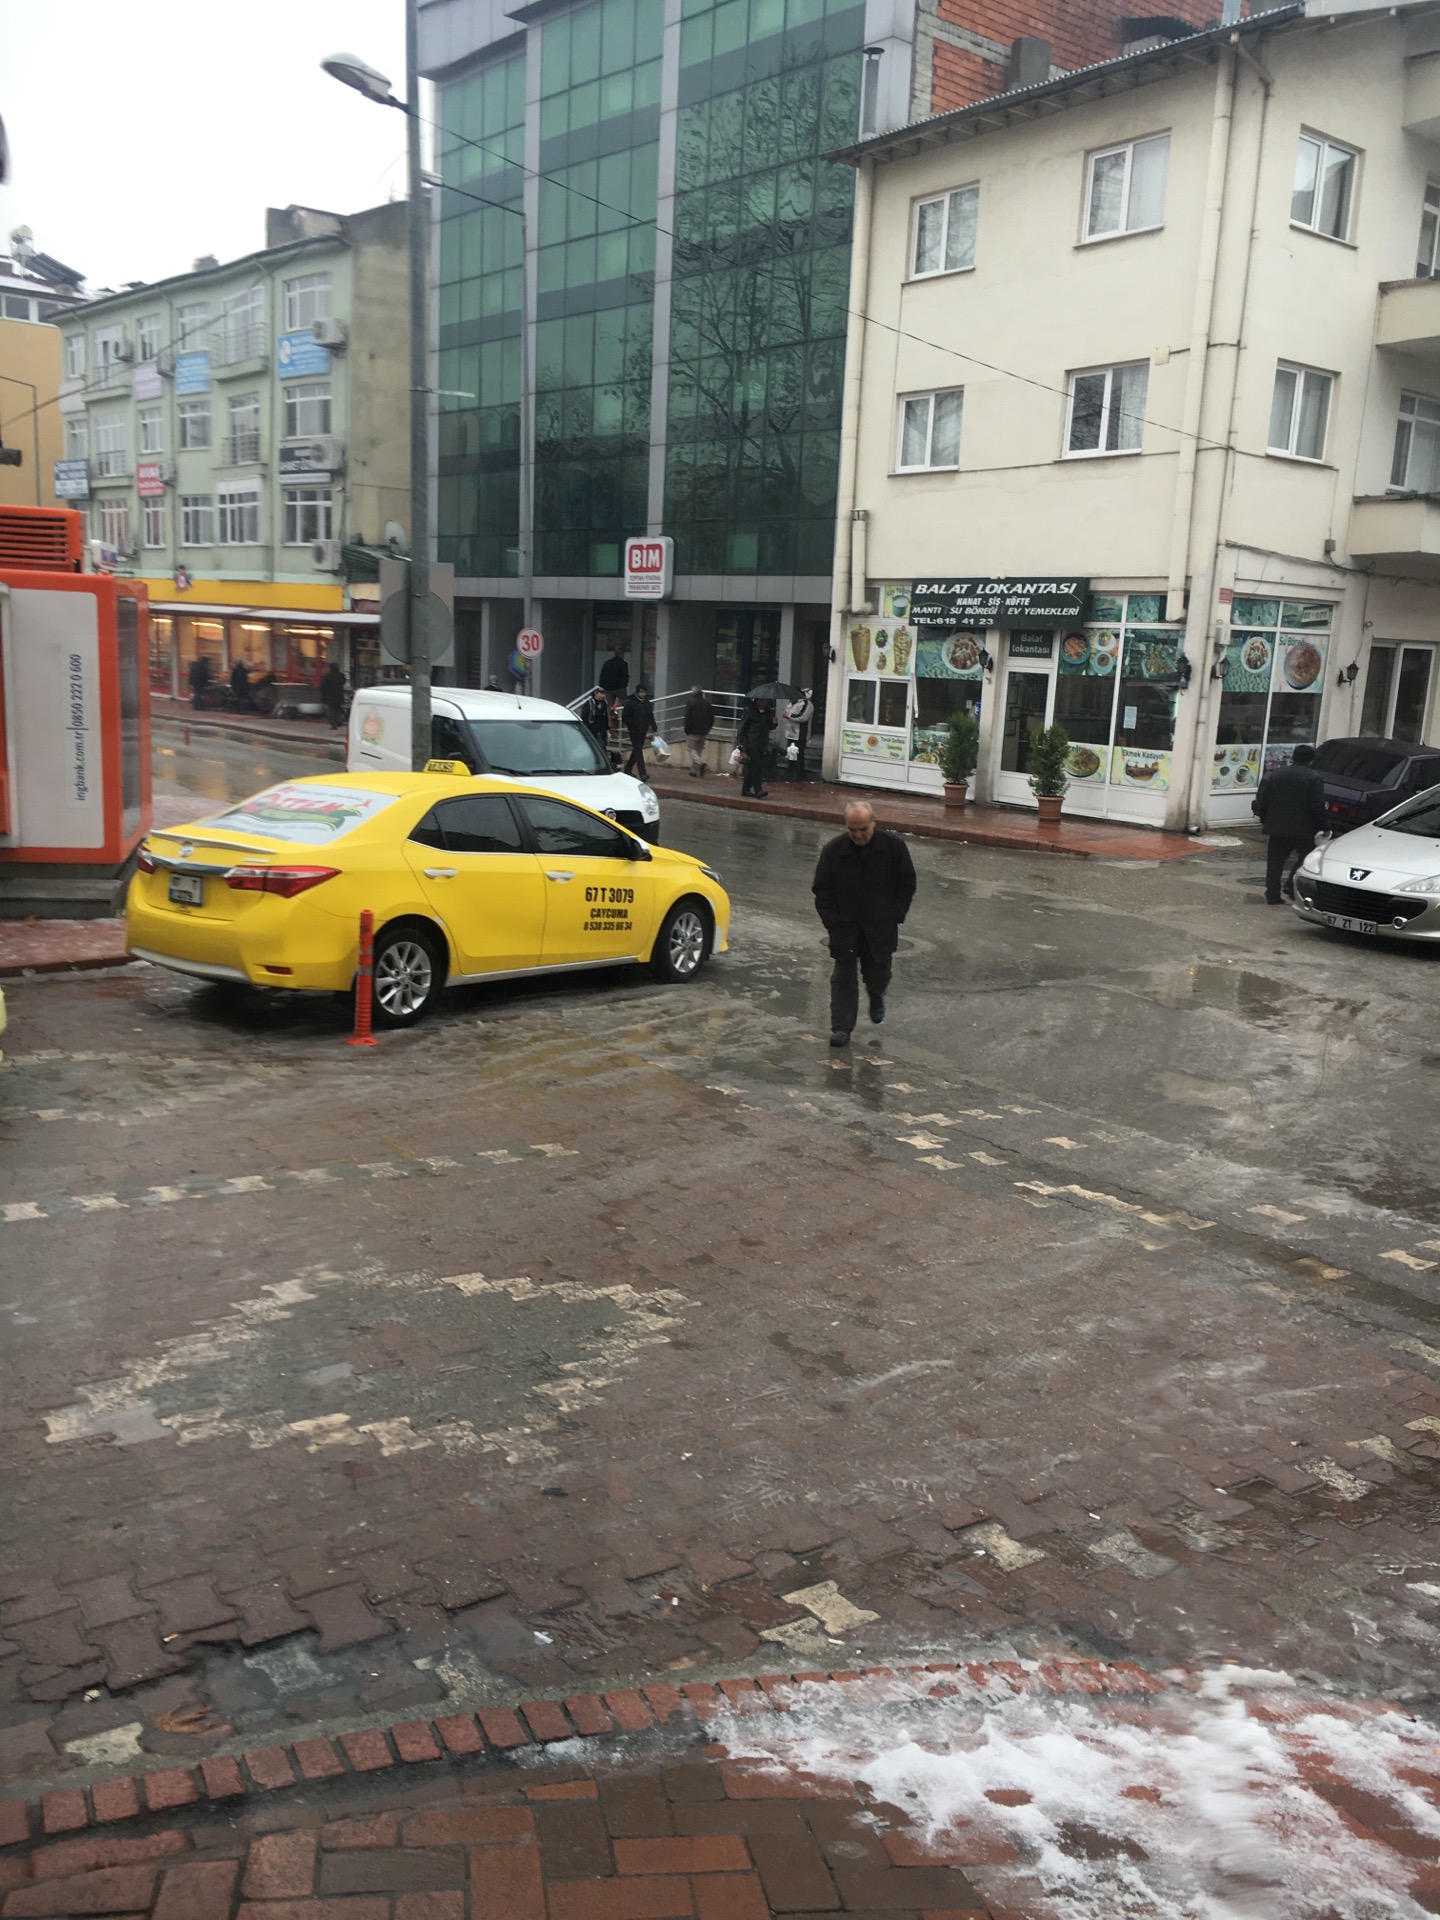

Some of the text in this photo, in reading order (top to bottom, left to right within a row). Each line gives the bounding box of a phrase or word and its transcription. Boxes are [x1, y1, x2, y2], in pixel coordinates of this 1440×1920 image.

[915, 584, 971, 594] BALAT
[976, 583, 1077, 594] LOKANTASI
[956, 598, 982, 606] KANAT
[1005, 597, 1031, 606] KÖFTE
[949, 607, 961, 615] SU
[1007, 608, 1023, 616] EV
[1024, 606, 1079, 616] YEMEKLERİ
[522, 634, 540, 651] 30
[1021, 634, 1043, 643] Balat
[69, 654, 82, 673] 600
[70, 683, 83, 701] 222
[71, 703, 84, 727] 0850
[74, 731, 88, 801] ingbank.com.tr
[585, 887, 634, 903] 67 T 3079
[1328, 915, 1373, 933] 67 ZT 122
